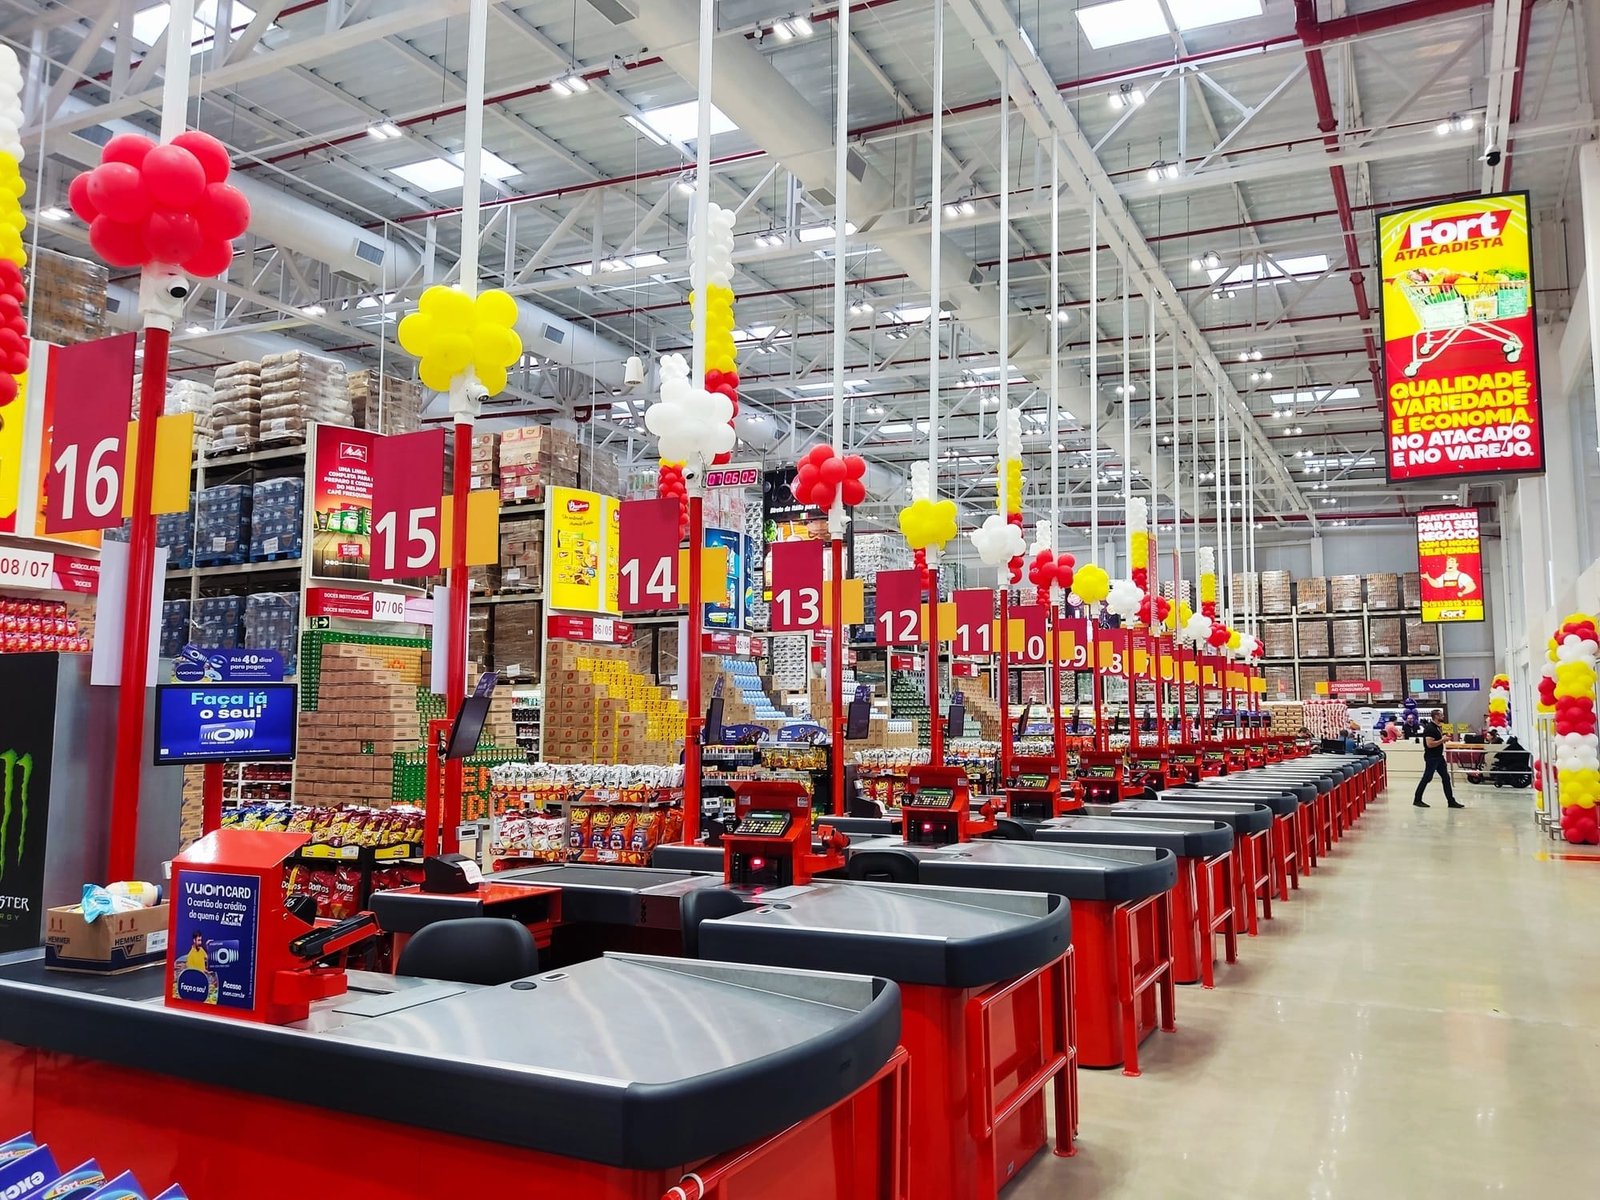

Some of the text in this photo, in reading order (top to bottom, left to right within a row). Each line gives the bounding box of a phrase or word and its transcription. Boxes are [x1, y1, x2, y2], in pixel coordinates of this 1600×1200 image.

[1410, 212, 1500, 248] Fort
[1394, 237, 1503, 262] ATACADISTA
[1390, 370, 1531, 399] QUALIDADE,
[1391, 388, 1529, 417] VARIEDADE
[1392, 407, 1534, 434] E ECONOMIA,
[1392, 424, 1531, 450] NO ATACADO
[1393, 441, 1534, 467] E NO VAREJO.
[54, 437, 120, 520] 16
[328, 471, 356, 479] COMPLETA
[346, 485, 367, 493] MELHOR
[355, 480, 373, 488] CONSU
[1418, 511, 1478, 522] PRATICIDADE
[1418, 519, 1478, 532] PARA SEU
[375, 507, 436, 571] 15
[1418, 528, 1479, 542] NEGÓCIO
[1419, 546, 1479, 556] TELEVENDAS
[1, 558, 49, 578] 08/07
[621, 556, 676, 605] 14
[375, 600, 403, 615] 07/06
[775, 587, 820, 625] 13
[1440, 610, 1465, 618] Fort
[878, 609, 919, 642] 12
[956, 623, 989, 652] 11
[242, 655, 259, 664] 40
[191, 691, 268, 708] Faça já
[200, 709, 214, 719] o
[187, 896, 247, 912] O cartão de crédito
[189, 910, 197, 919] de
[197, 912, 215, 922] quem
[48, 935, 71, 945] HEMMER
[180, 982, 193, 993] Faça
[223, 980, 242, 991] Acesse
